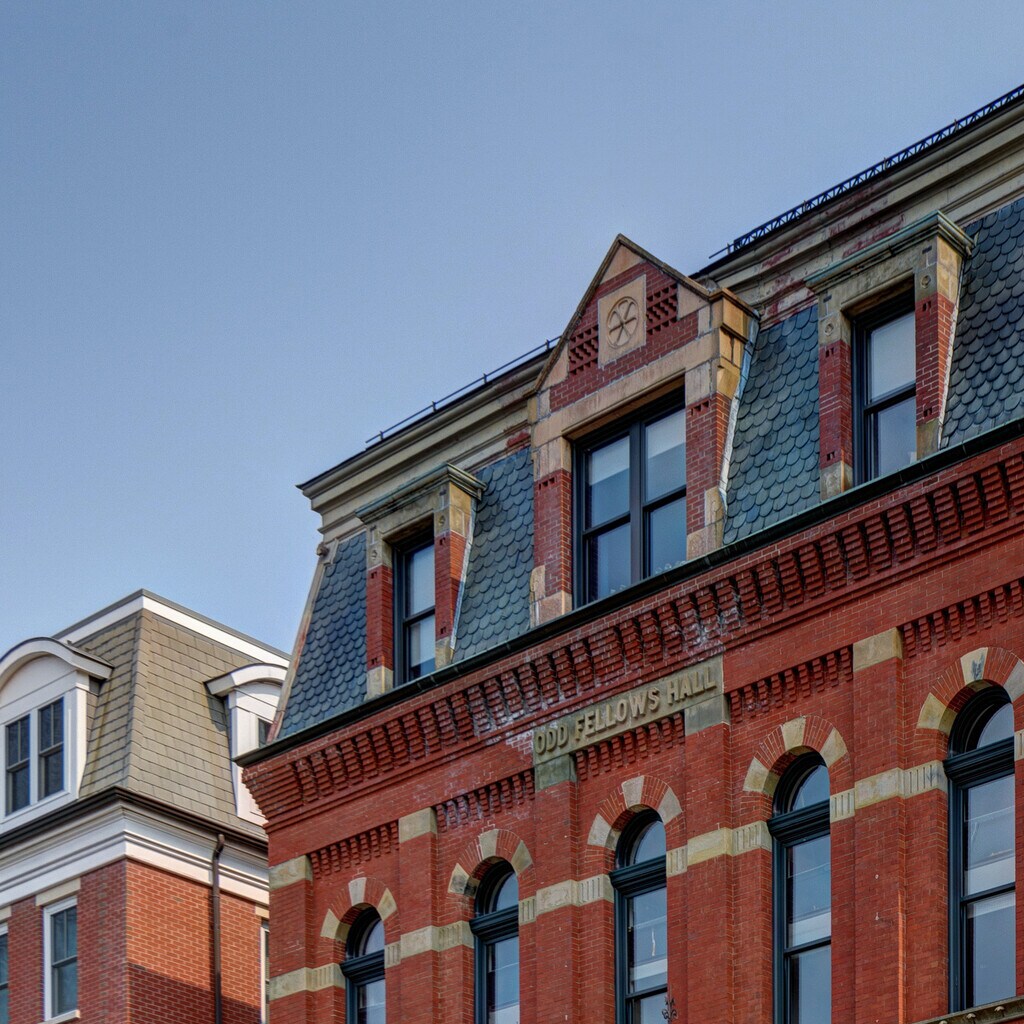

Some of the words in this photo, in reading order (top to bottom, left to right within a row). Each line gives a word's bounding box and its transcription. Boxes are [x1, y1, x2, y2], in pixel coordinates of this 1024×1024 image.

[535, 723, 569, 755] ODD
[574, 687, 661, 742] FELLOWS
[667, 667, 718, 705] HALL
